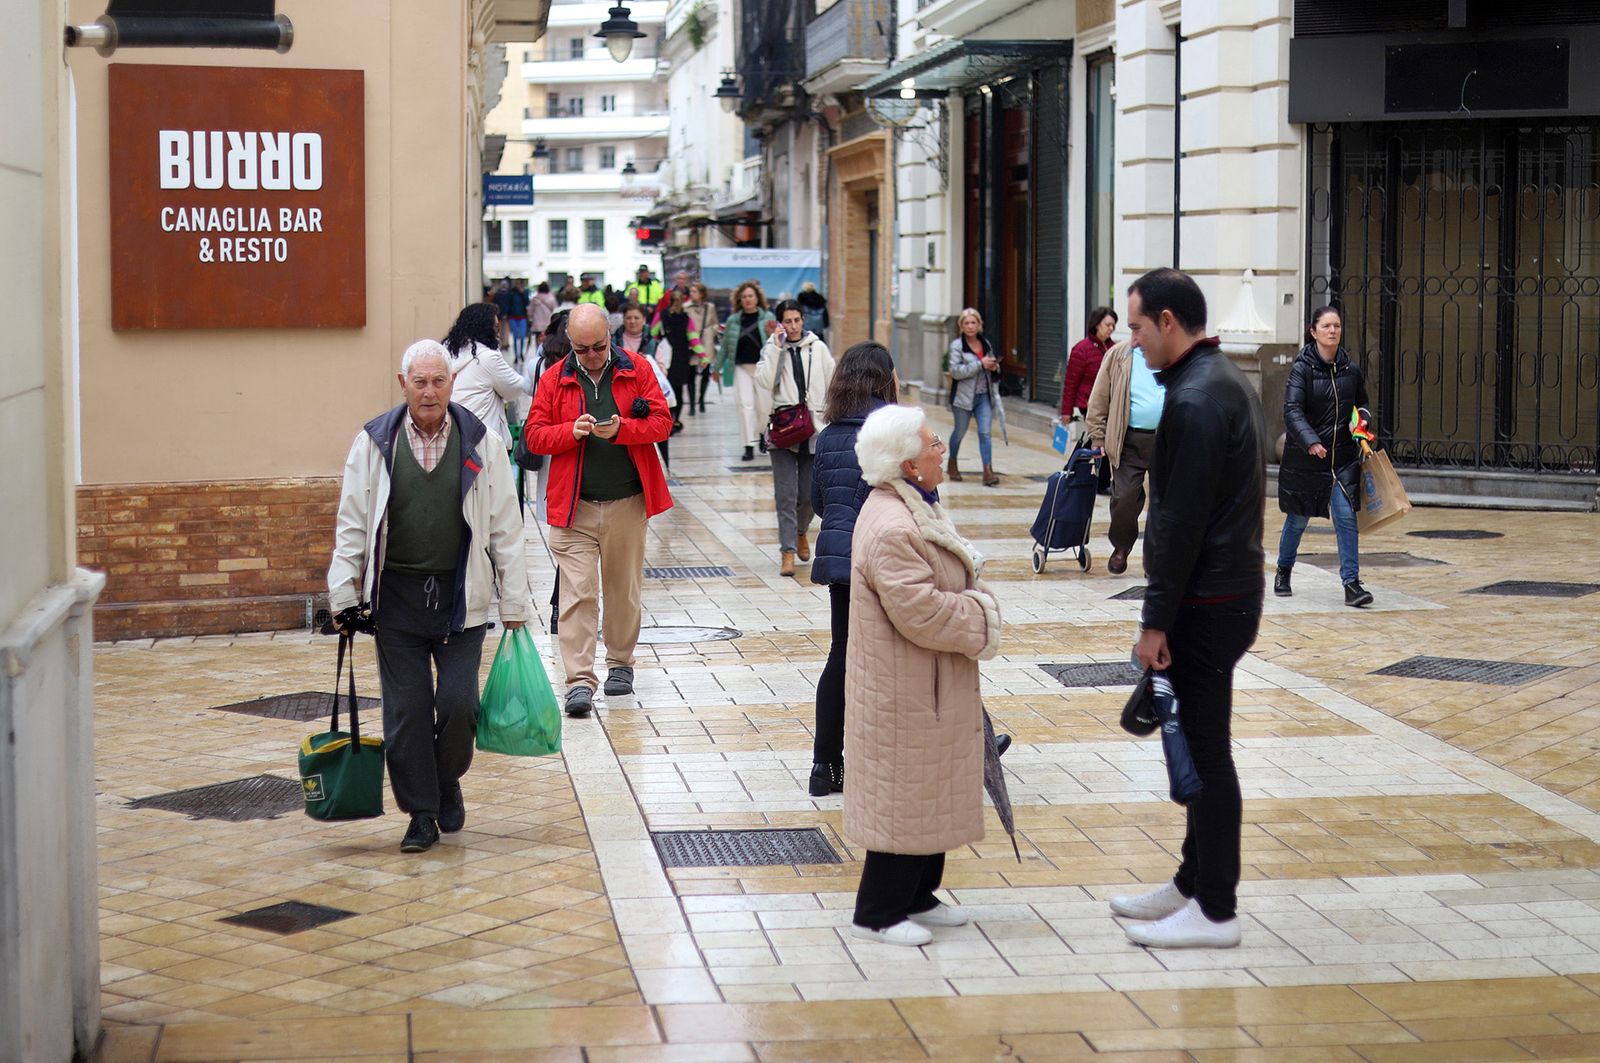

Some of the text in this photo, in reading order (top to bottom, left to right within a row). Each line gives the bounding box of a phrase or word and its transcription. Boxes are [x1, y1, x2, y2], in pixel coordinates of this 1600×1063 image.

[159, 130, 323, 190] BURRO
[161, 206, 323, 232] CANAGLIA BAR
[199, 237, 288, 262] & RESTO
